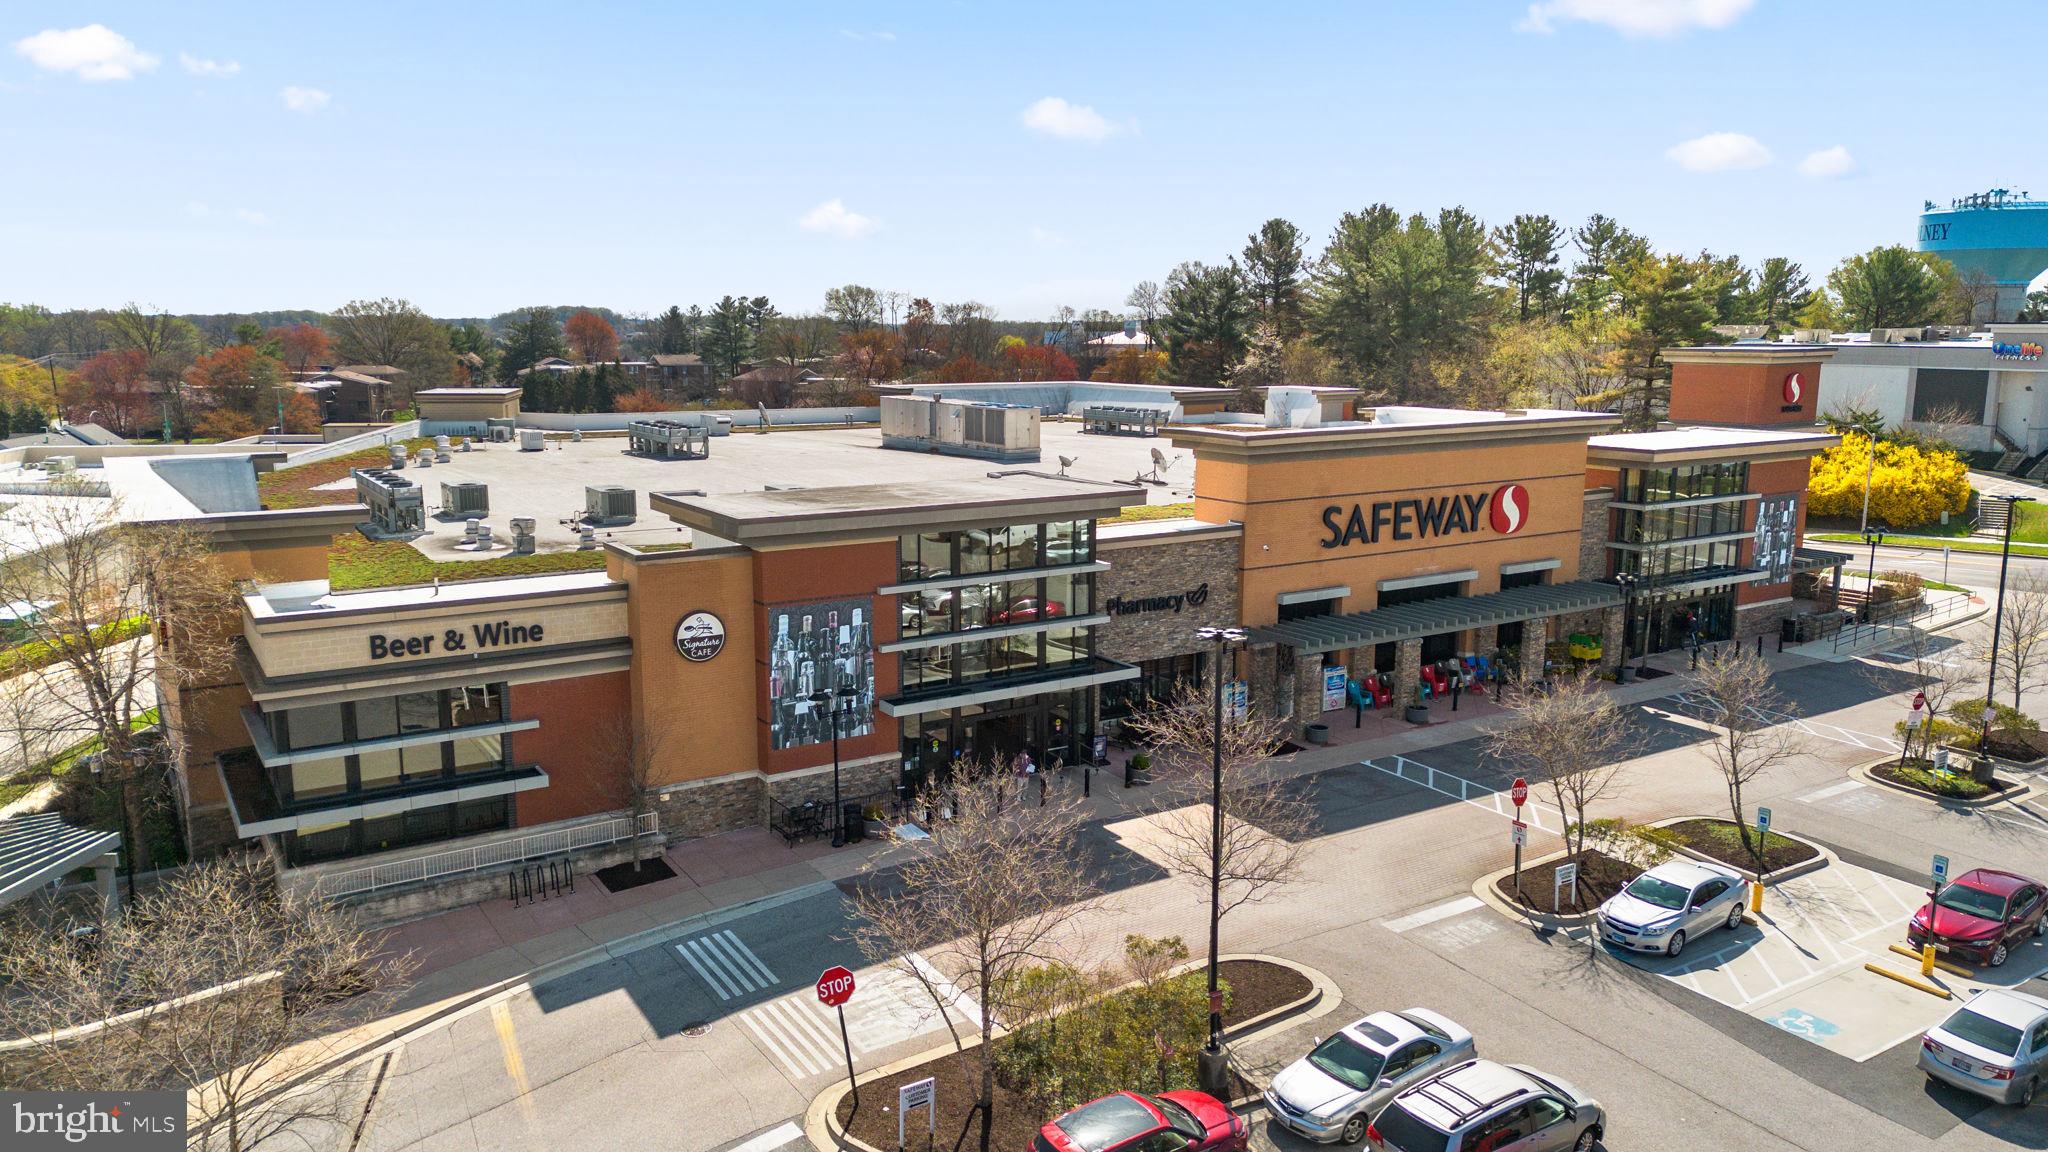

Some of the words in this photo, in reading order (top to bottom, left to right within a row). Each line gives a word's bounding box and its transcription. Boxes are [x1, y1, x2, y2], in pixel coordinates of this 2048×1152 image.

[1320, 493, 1489, 549] SAFEWAY
[1106, 594, 1185, 616] Pharmacy
[369, 634, 434, 660] Beer
[443, 629, 466, 652] &
[472, 620, 544, 648] Wine
[682, 638, 720, 650] Signature
[691, 648, 712, 657] CAFE
[1512, 787, 1527, 799] STOP
[820, 975, 852, 998] STOP
